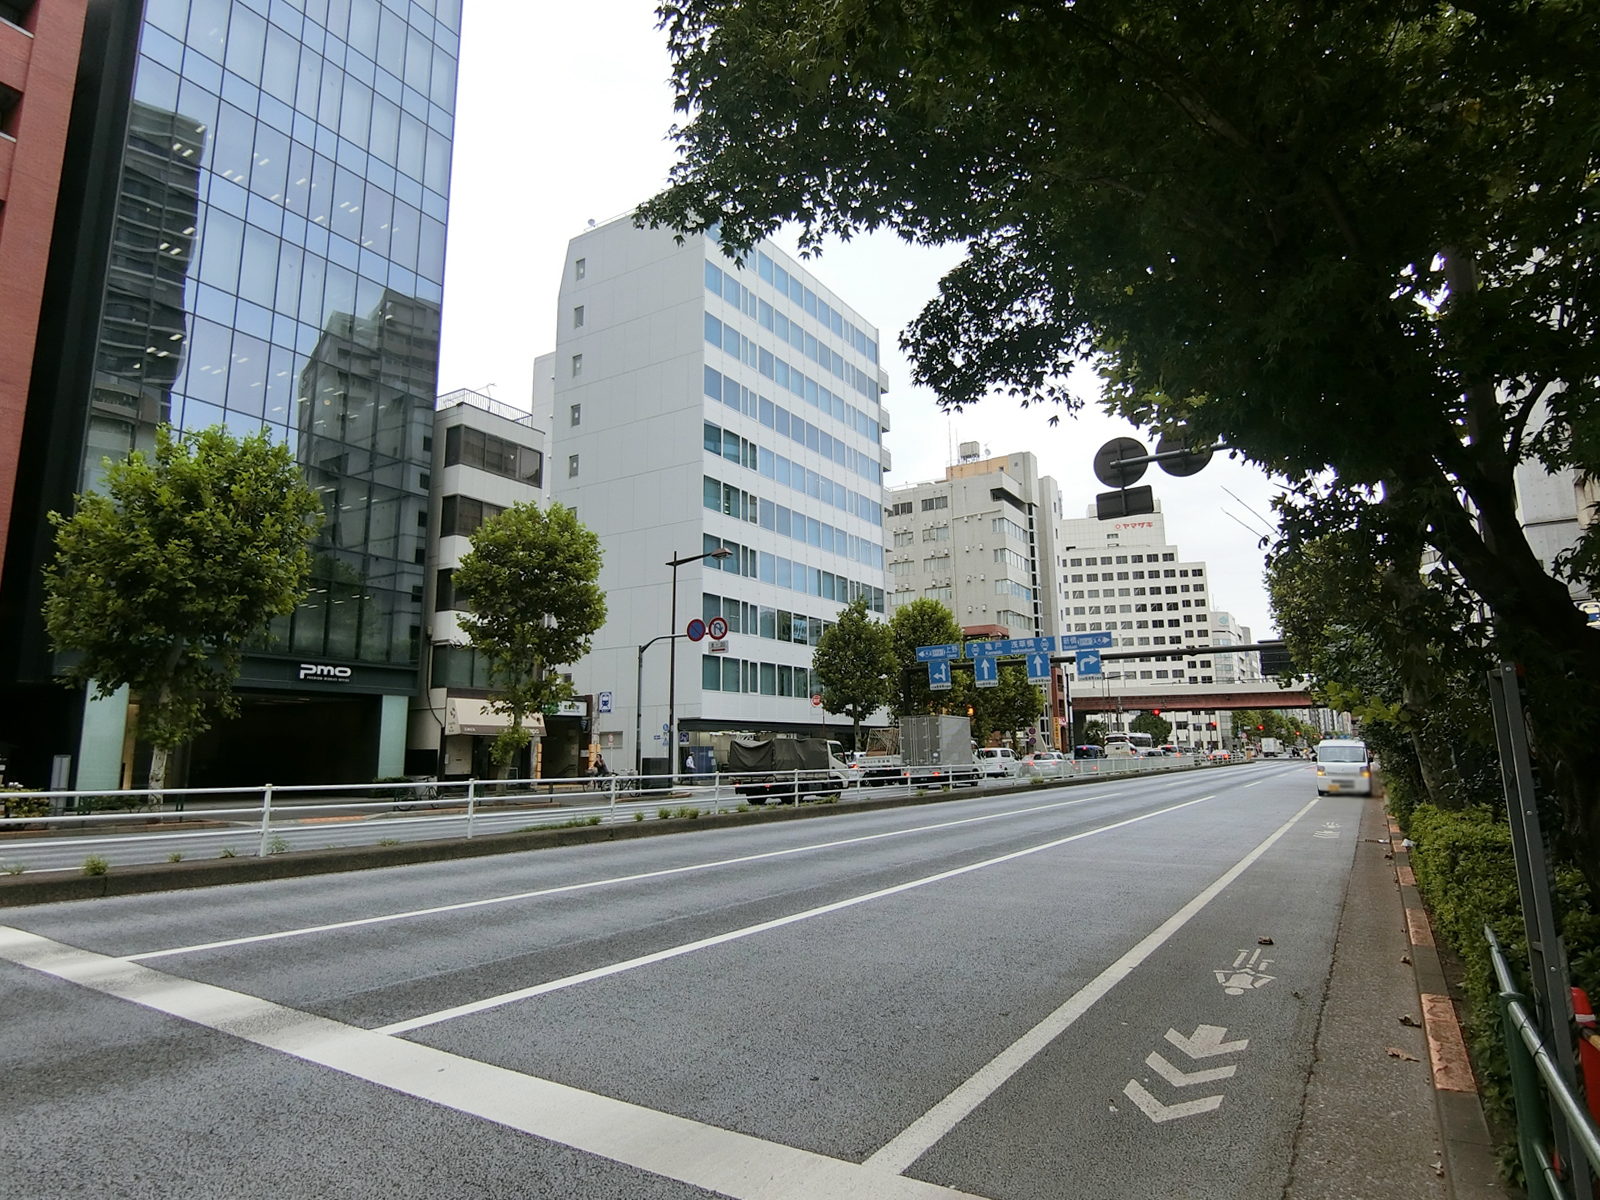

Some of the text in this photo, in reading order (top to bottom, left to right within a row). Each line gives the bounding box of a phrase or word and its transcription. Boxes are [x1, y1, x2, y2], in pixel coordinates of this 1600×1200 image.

[1122, 521, 1153, 529] ヤマザキ
[1011, 639, 1035, 649] 浅草橋
[946, 645, 958, 654] 上野
